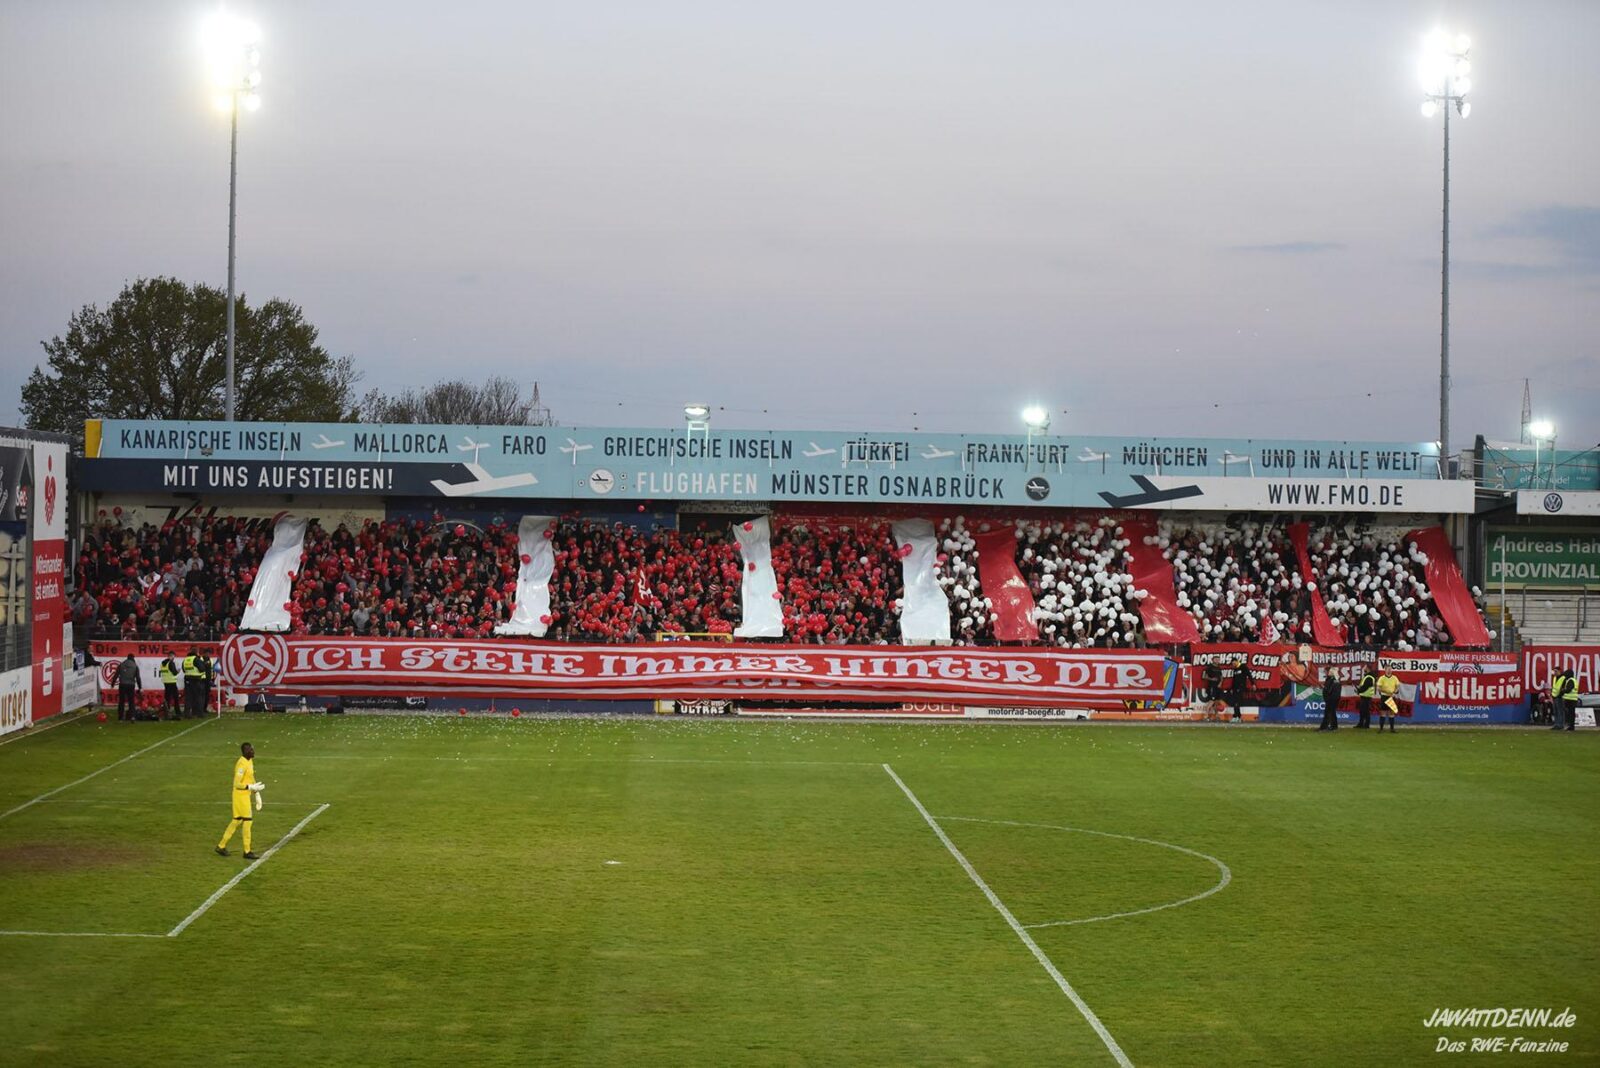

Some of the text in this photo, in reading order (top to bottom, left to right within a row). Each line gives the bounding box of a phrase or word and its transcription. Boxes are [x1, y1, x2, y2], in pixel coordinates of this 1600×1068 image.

[121, 429, 301, 451] KANARISCHE INSELN
[354, 433, 448, 453] MALLORCA
[503, 436, 546, 455] FARO
[604, 437, 792, 459] GRIECHISCHE INSELN
[847, 438, 909, 461] TÜRKEI
[967, 443, 1069, 464] FRANKFURT
[1123, 443, 1207, 466] MÜNCHEN
[1262, 449, 1419, 471] UND IN ALLE WELT
[164, 465, 393, 490] MIT UNS AUFSTEIGEN!
[637, 472, 757, 494] FLUGHAFEN
[772, 470, 1004, 498] MÜNSTER OSNABRÜCK
[1268, 484, 1403, 506] WWW.FMO.DE
[1493, 537, 1564, 553] Andreas
[1491, 561, 1600, 579] PROVINZIAL
[138, 645, 170, 655] RWE
[1252, 654, 1280, 667] CREW
[292, 647, 385, 671] ICH
[1055, 662, 1152, 689] DIR
[1380, 660, 1438, 672] West Boys
[680, 705, 725, 714] ULTRAS
[988, 708, 1066, 717] motorrad-boegel.de
